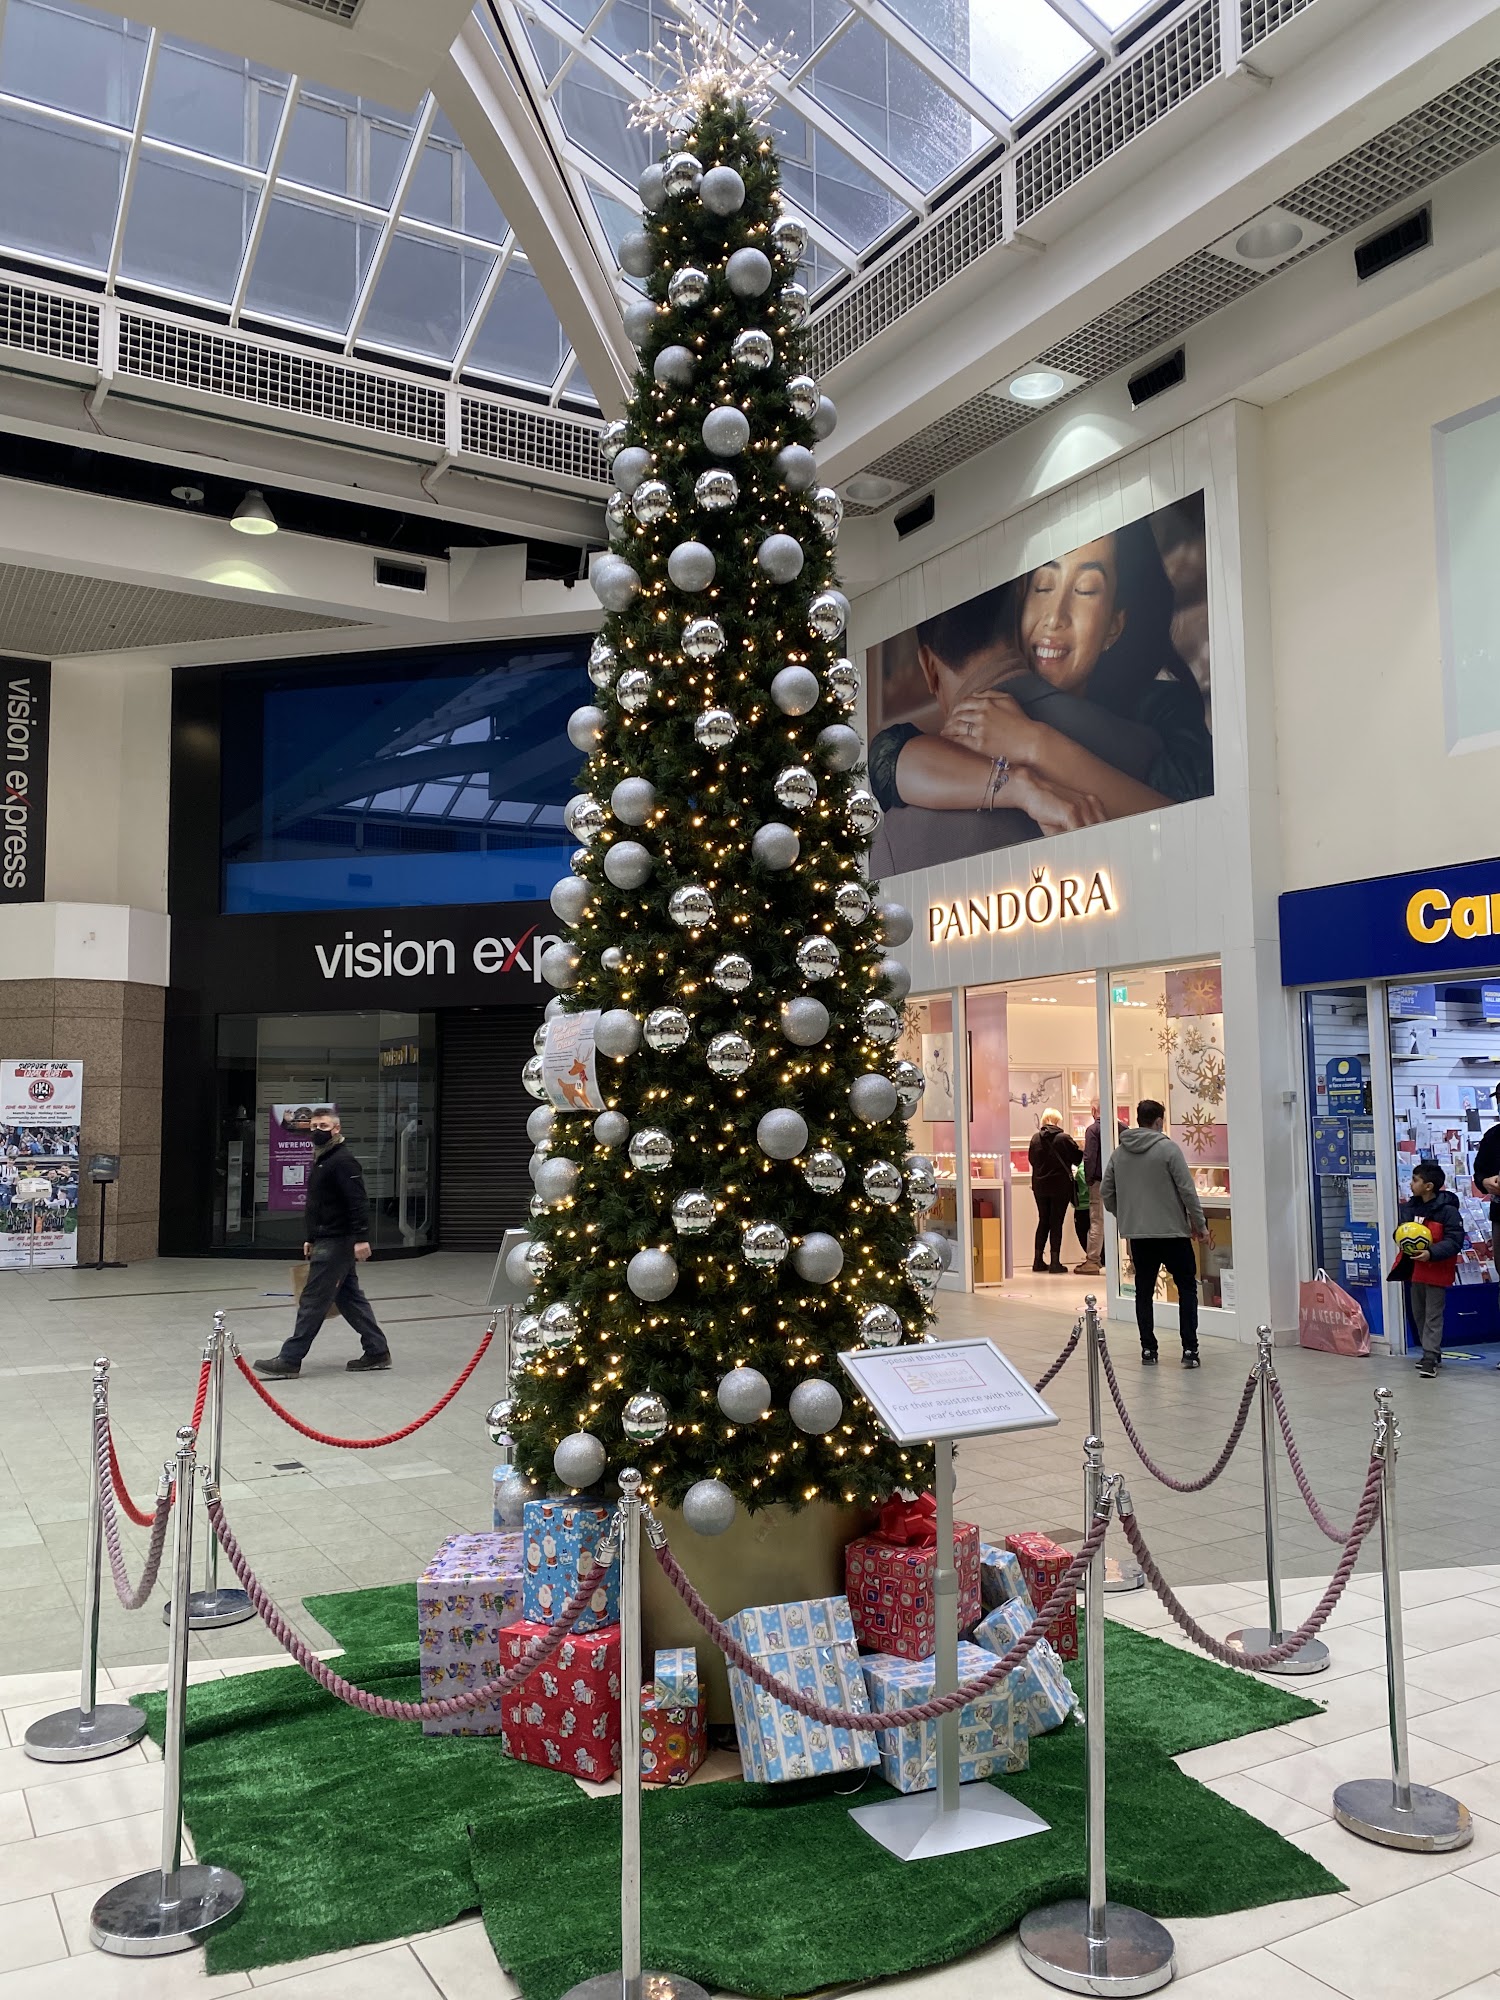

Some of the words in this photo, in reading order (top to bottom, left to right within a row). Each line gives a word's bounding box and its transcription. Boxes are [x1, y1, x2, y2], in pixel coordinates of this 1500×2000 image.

[6, 678, 38, 761] vision
[0, 770, 34, 889] express
[929, 867, 1112, 942] PANDORA
[315, 929, 456, 979] vision
[473, 923, 566, 984] exp
[1352, 1244, 1375, 1252] HAPPY
[1354, 1251, 1371, 1259] DAYS
[881, 1354, 914, 1366] Special
[915, 1352, 947, 1363] thanks
[947, 1351, 958, 1359] to
[892, 1404, 908, 1412] For
[910, 1400, 933, 1410] their
[936, 1394, 984, 1407] assistance
[984, 1391, 1006, 1401] with
[1007, 1389, 1024, 1399] this
[924, 1409, 955, 1422] year's
[956, 1403, 1011, 1417] decorations
[579, 1520, 600, 1531] Santa
